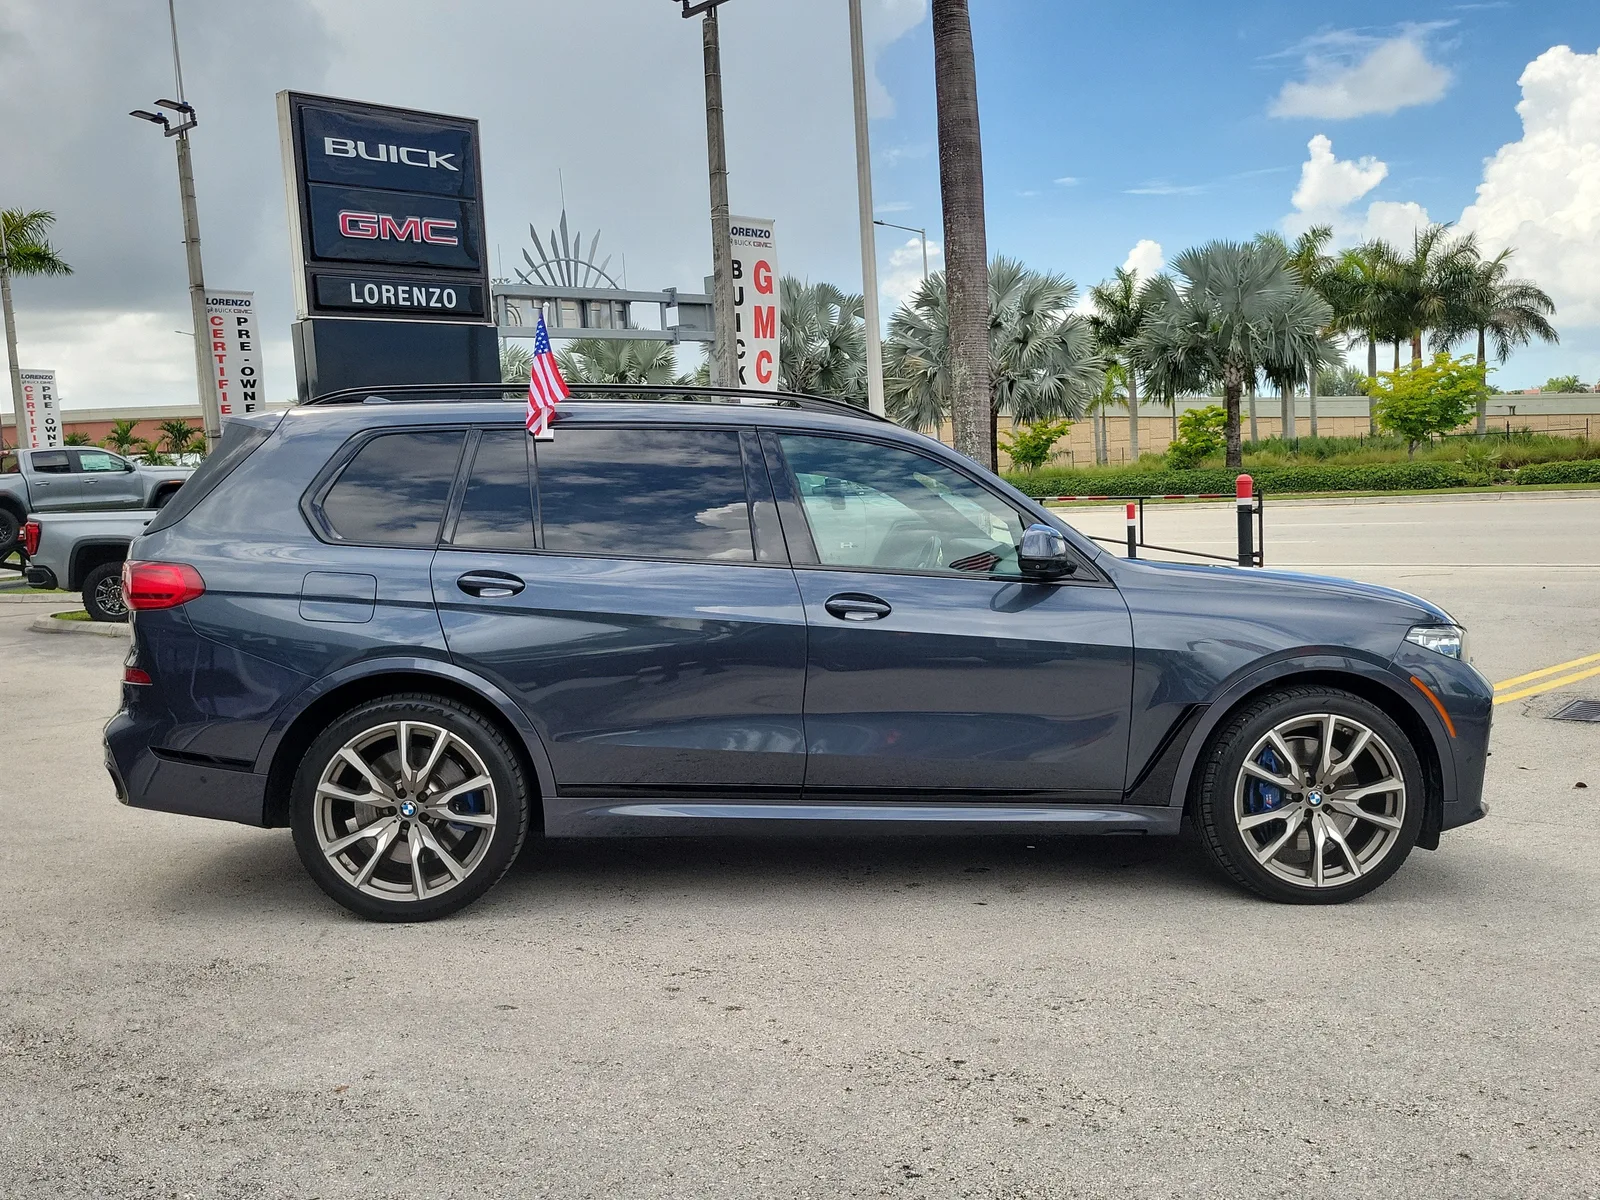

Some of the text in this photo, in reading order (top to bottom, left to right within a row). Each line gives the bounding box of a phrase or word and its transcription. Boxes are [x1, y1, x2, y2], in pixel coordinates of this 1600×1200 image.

[324, 137, 459, 171] BUICK
[339, 210, 458, 246] GMC
[729, 226, 771, 239] ORENZO
[205, 297, 251, 307] LORENZO
[350, 282, 457, 309] LORENZO
[753, 260, 775, 384] GMC
